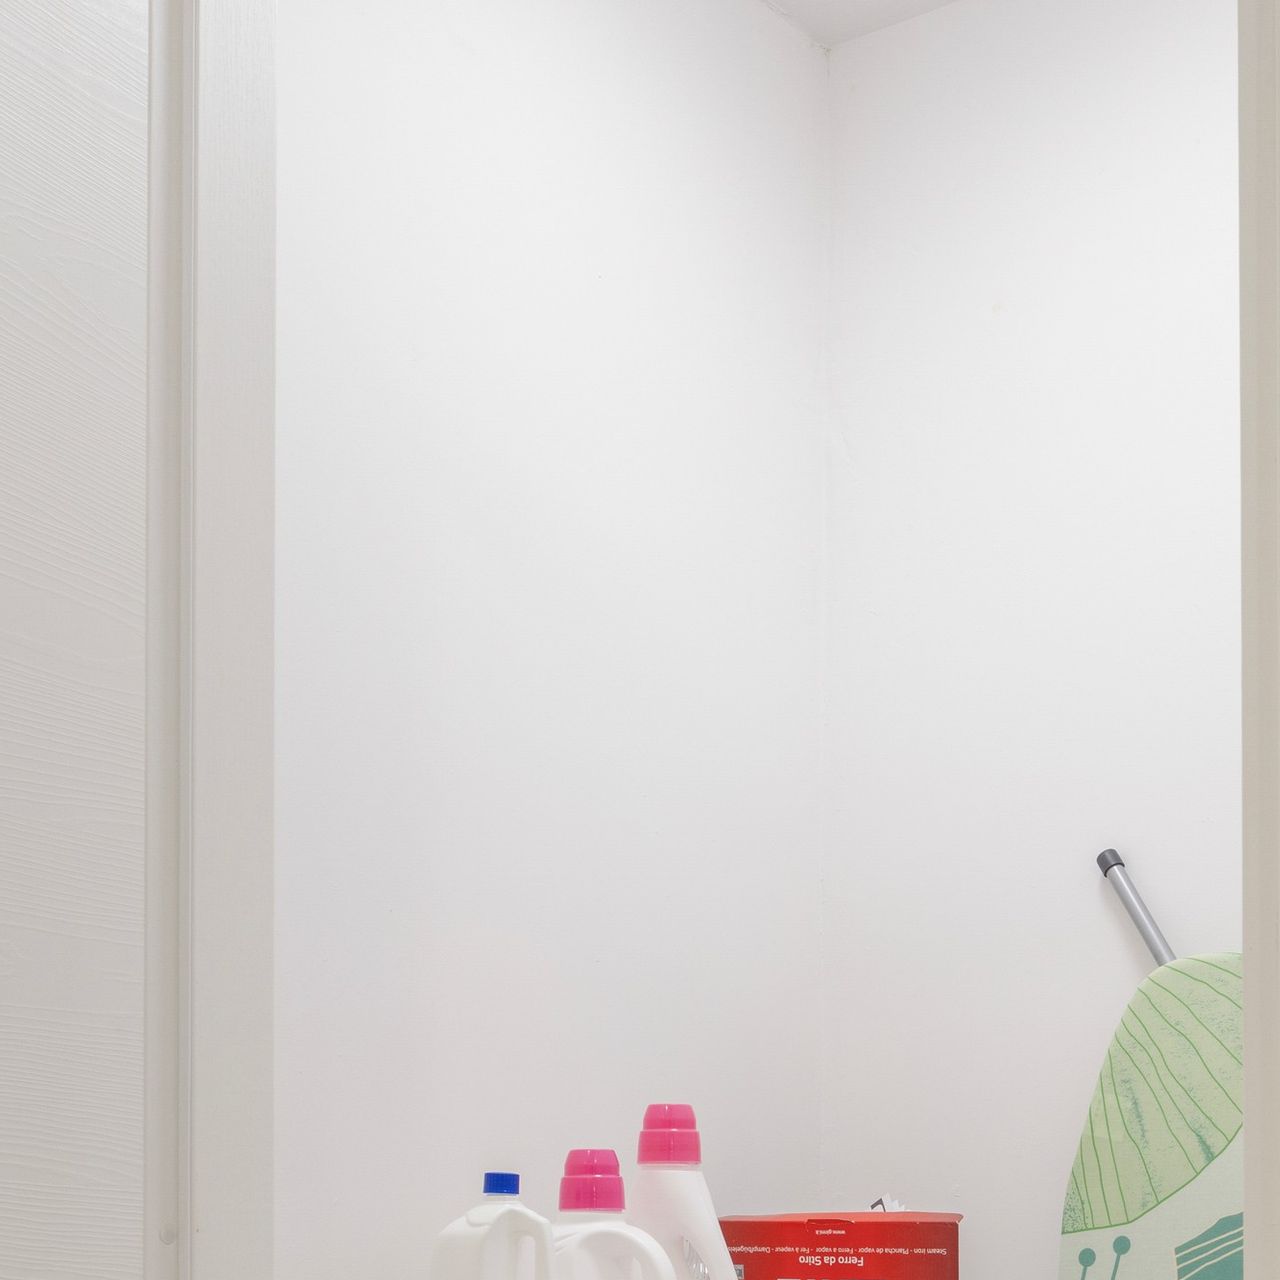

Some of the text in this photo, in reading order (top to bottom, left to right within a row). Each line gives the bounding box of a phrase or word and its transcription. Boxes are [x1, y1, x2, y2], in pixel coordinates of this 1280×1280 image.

[799, 1256, 864, 1266] Ferro da Stiro
